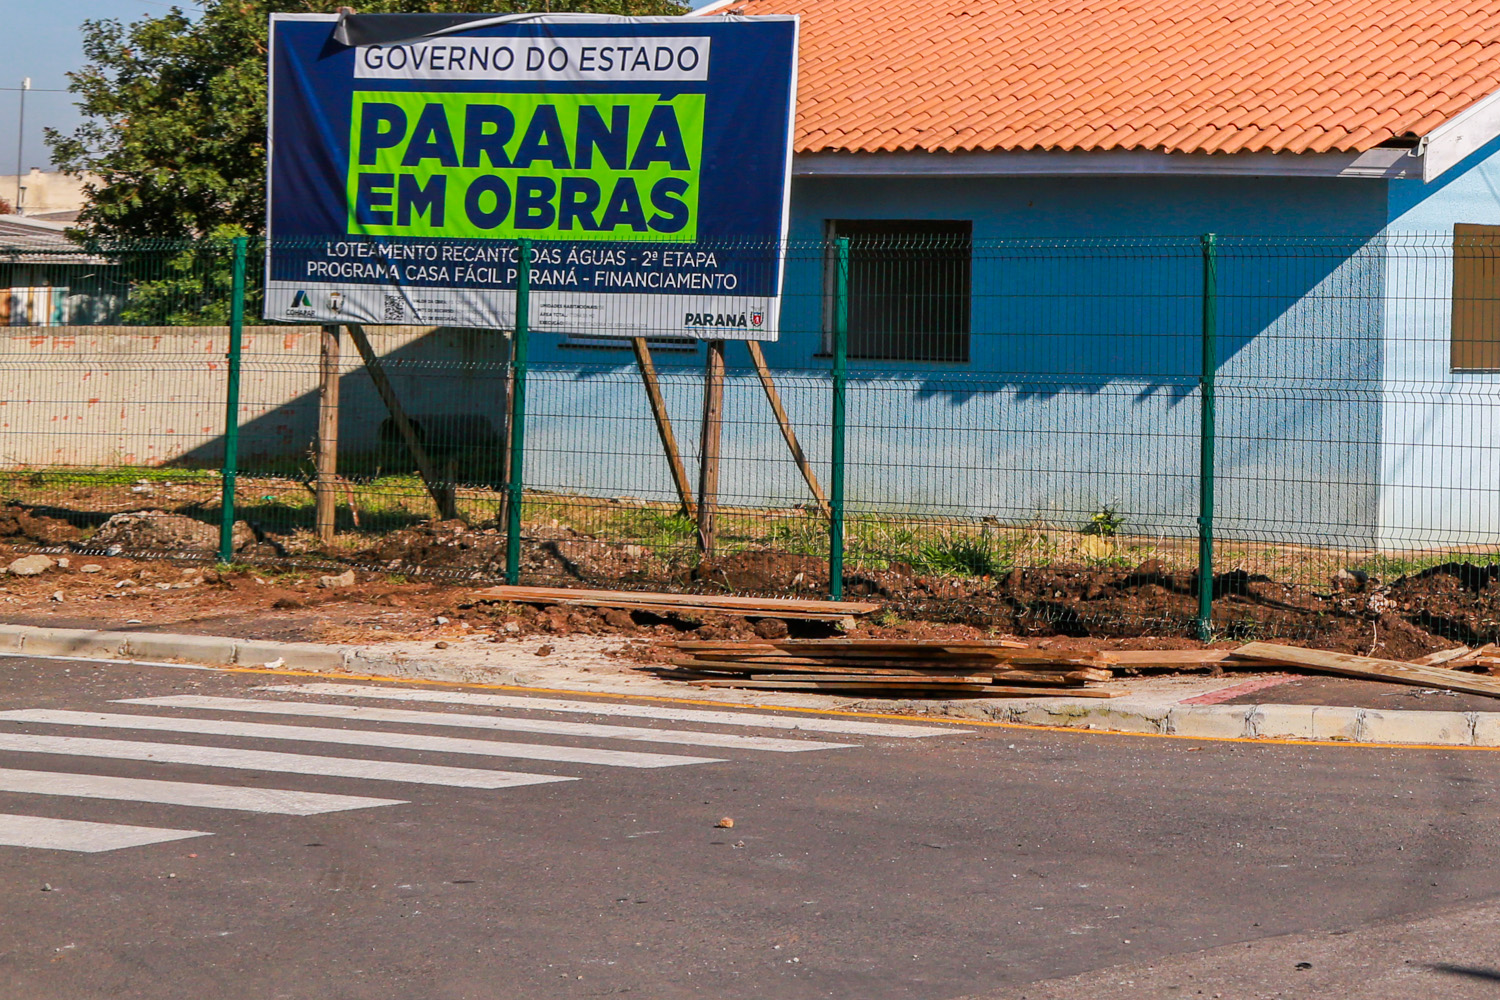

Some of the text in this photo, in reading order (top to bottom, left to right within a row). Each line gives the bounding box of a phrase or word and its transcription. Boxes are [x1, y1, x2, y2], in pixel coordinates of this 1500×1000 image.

[364, 45, 699, 72] GOVERNO DO ESTADO
[358, 93, 691, 171] PARANÁ
[356, 172, 690, 233] EM OBRAS
[327, 242, 438, 260] LOTEAMENTO
[442, 245, 519, 263] RECANTO
[529, 248, 561, 265] DAS
[566, 246, 626, 266] ÁGUAS
[641, 250, 658, 267] 2ª
[663, 252, 718, 268] ETAPA
[307, 261, 400, 279] PROGRAMA
[405, 265, 450, 281] CASA
[454, 264, 502, 283] FÁCIL
[507, 267, 578, 286] PRANÁ
[594, 270, 738, 289] FINANCIAMENTO
[684, 311, 747, 328] PARANÁ
